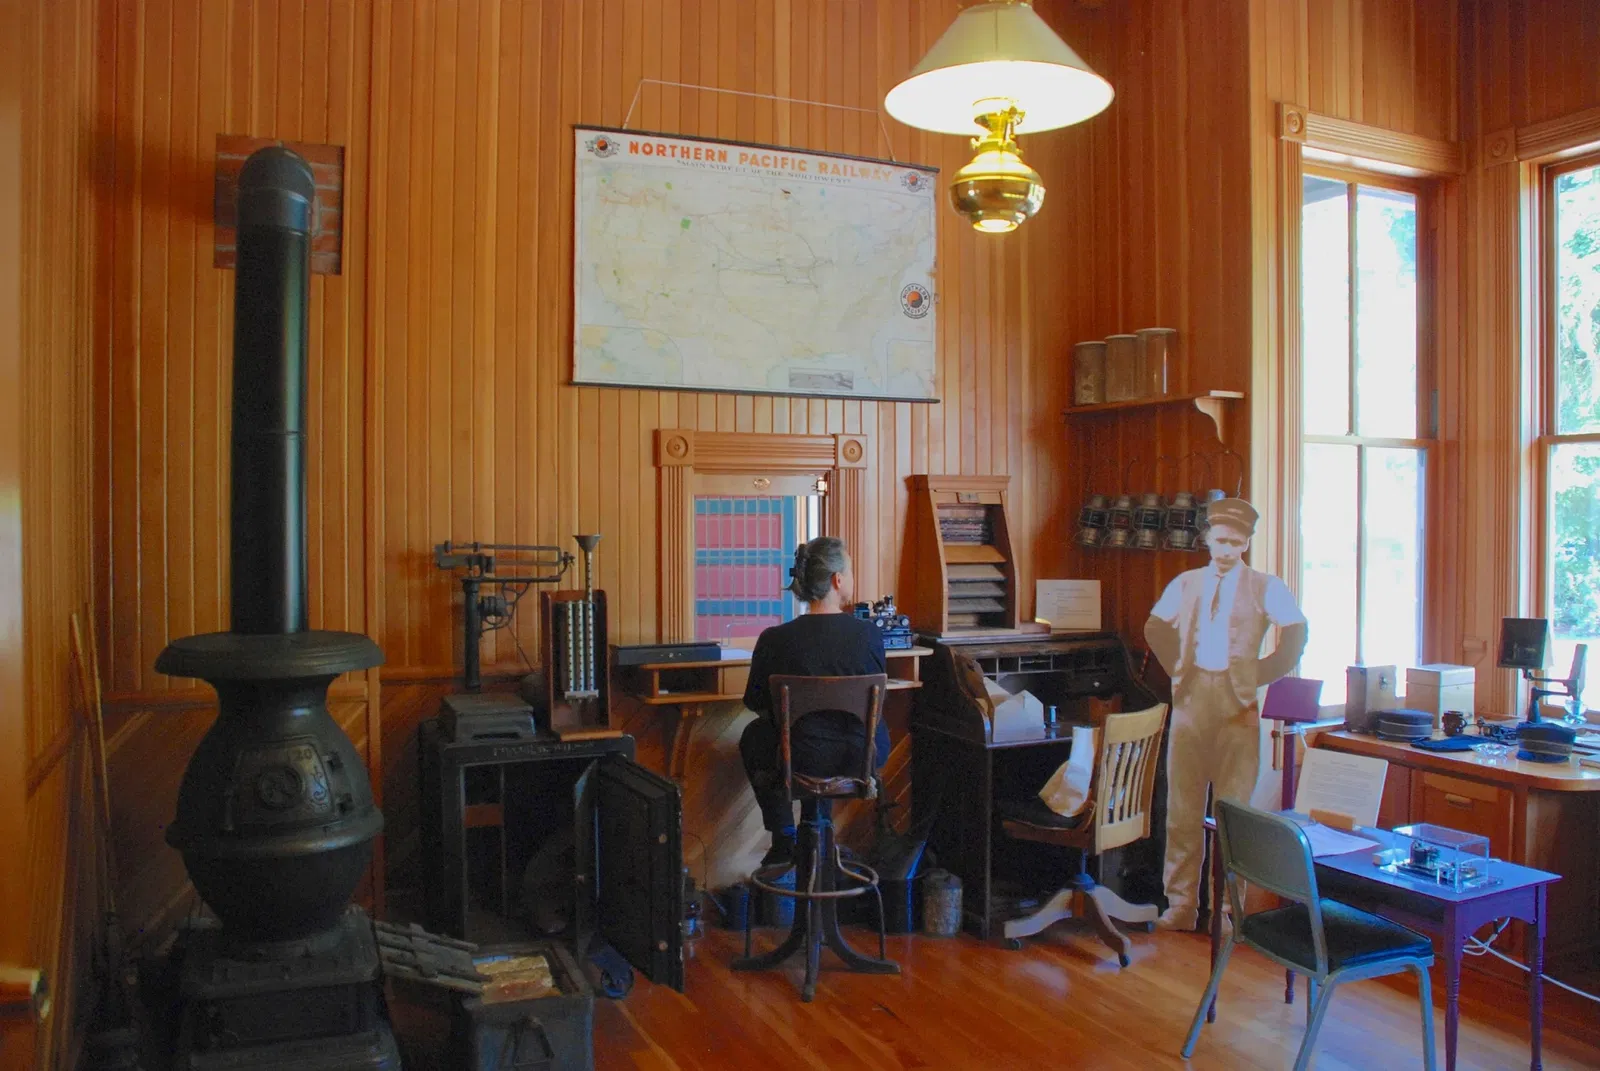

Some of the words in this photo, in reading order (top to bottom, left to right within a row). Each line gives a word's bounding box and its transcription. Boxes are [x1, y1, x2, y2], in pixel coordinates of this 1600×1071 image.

[628, 140, 728, 163] NORTHERN
[738, 151, 808, 172] PACIFIC
[818, 161, 893, 182] RAILWAY
[767, 169, 782, 177] THE
